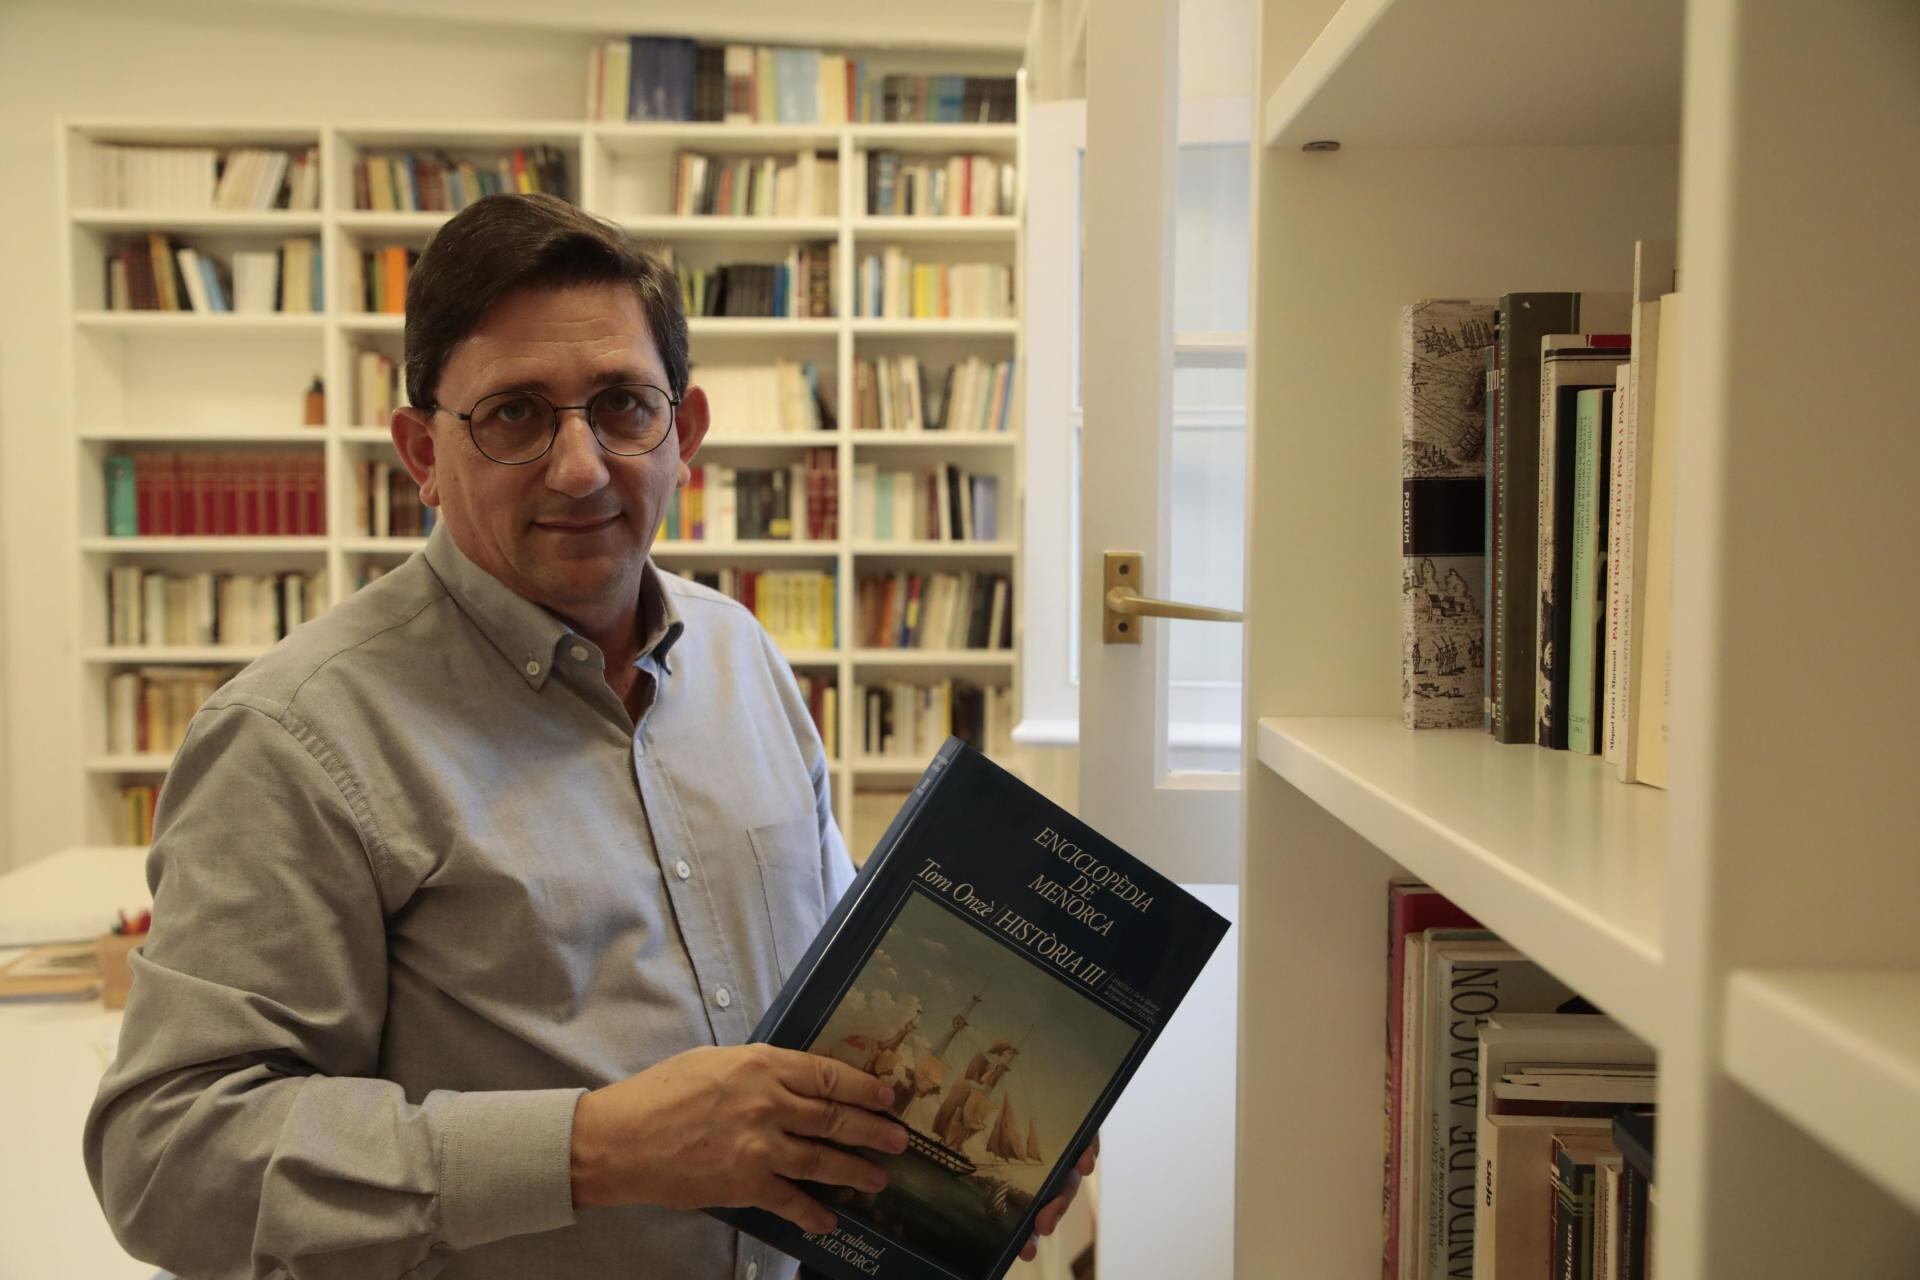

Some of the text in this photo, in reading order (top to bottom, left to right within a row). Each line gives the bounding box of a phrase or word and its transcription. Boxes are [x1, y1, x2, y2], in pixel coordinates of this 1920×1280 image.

[1033, 826, 1154, 913] ENCICLOPÈDIA
[1068, 874, 1101, 901] DE
[916, 857, 1107, 987] Tom Onzè HISTÒRIA III
[1027, 873, 1115, 937] MENORCA
[1450, 965, 1499, 1108] ARAGON
[1449, 1124, 1477, 1174] DE
[1485, 1159, 1493, 1207] afers
[815, 1234, 881, 1276] MENORCA
[841, 1232, 887, 1260] cultural
